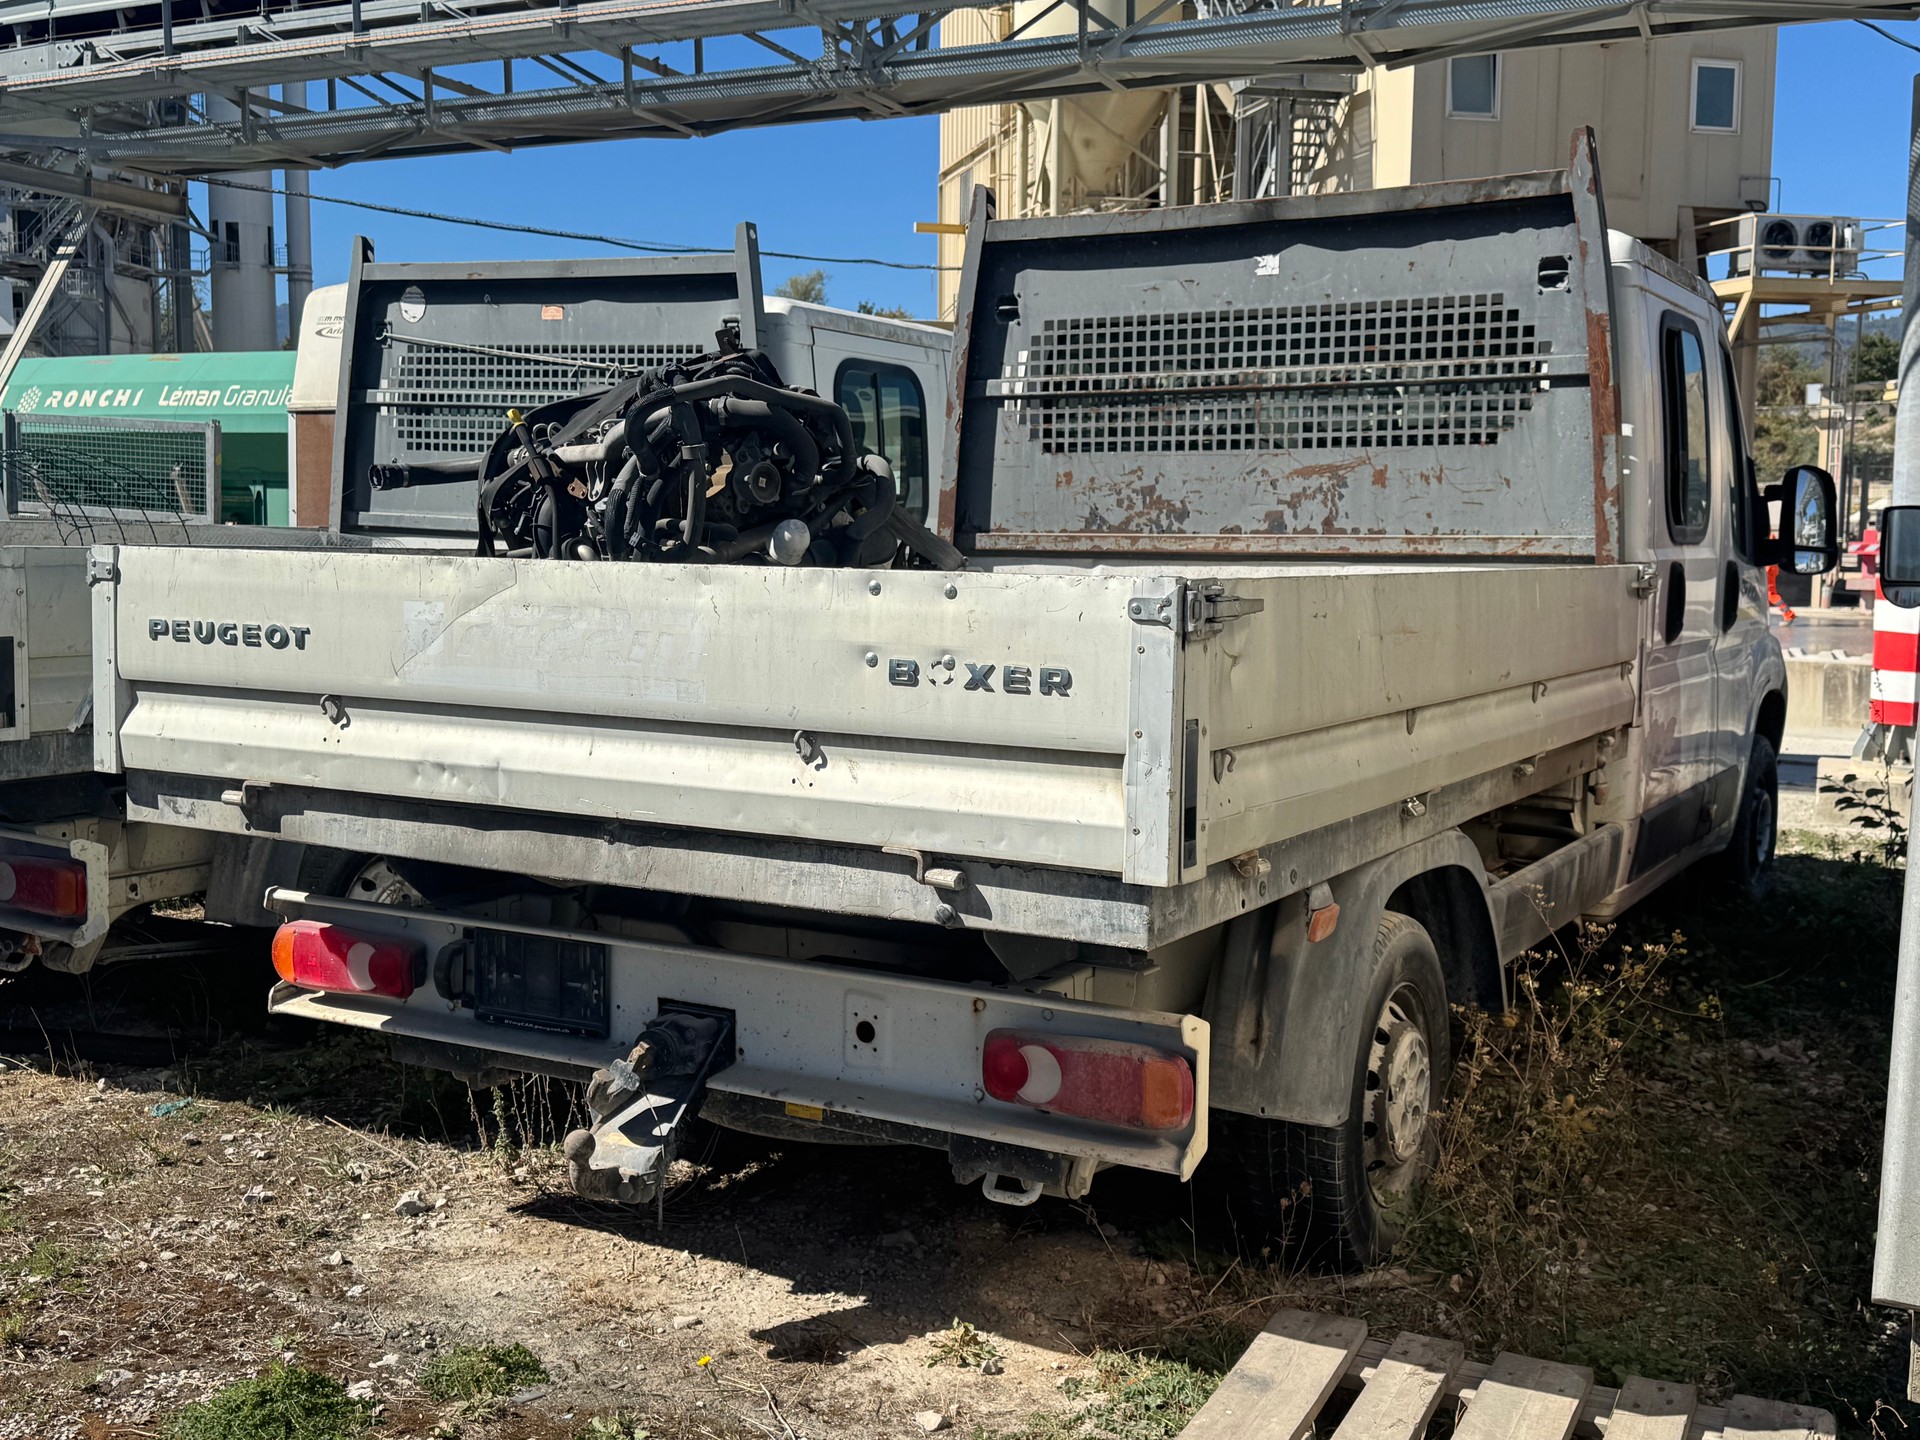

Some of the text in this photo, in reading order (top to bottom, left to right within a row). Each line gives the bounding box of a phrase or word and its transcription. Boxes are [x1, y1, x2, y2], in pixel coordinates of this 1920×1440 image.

[44, 388, 144, 408] RONCHI
[158, 385, 221, 407] Léman
[148, 618, 311, 651] PEUGEOT
